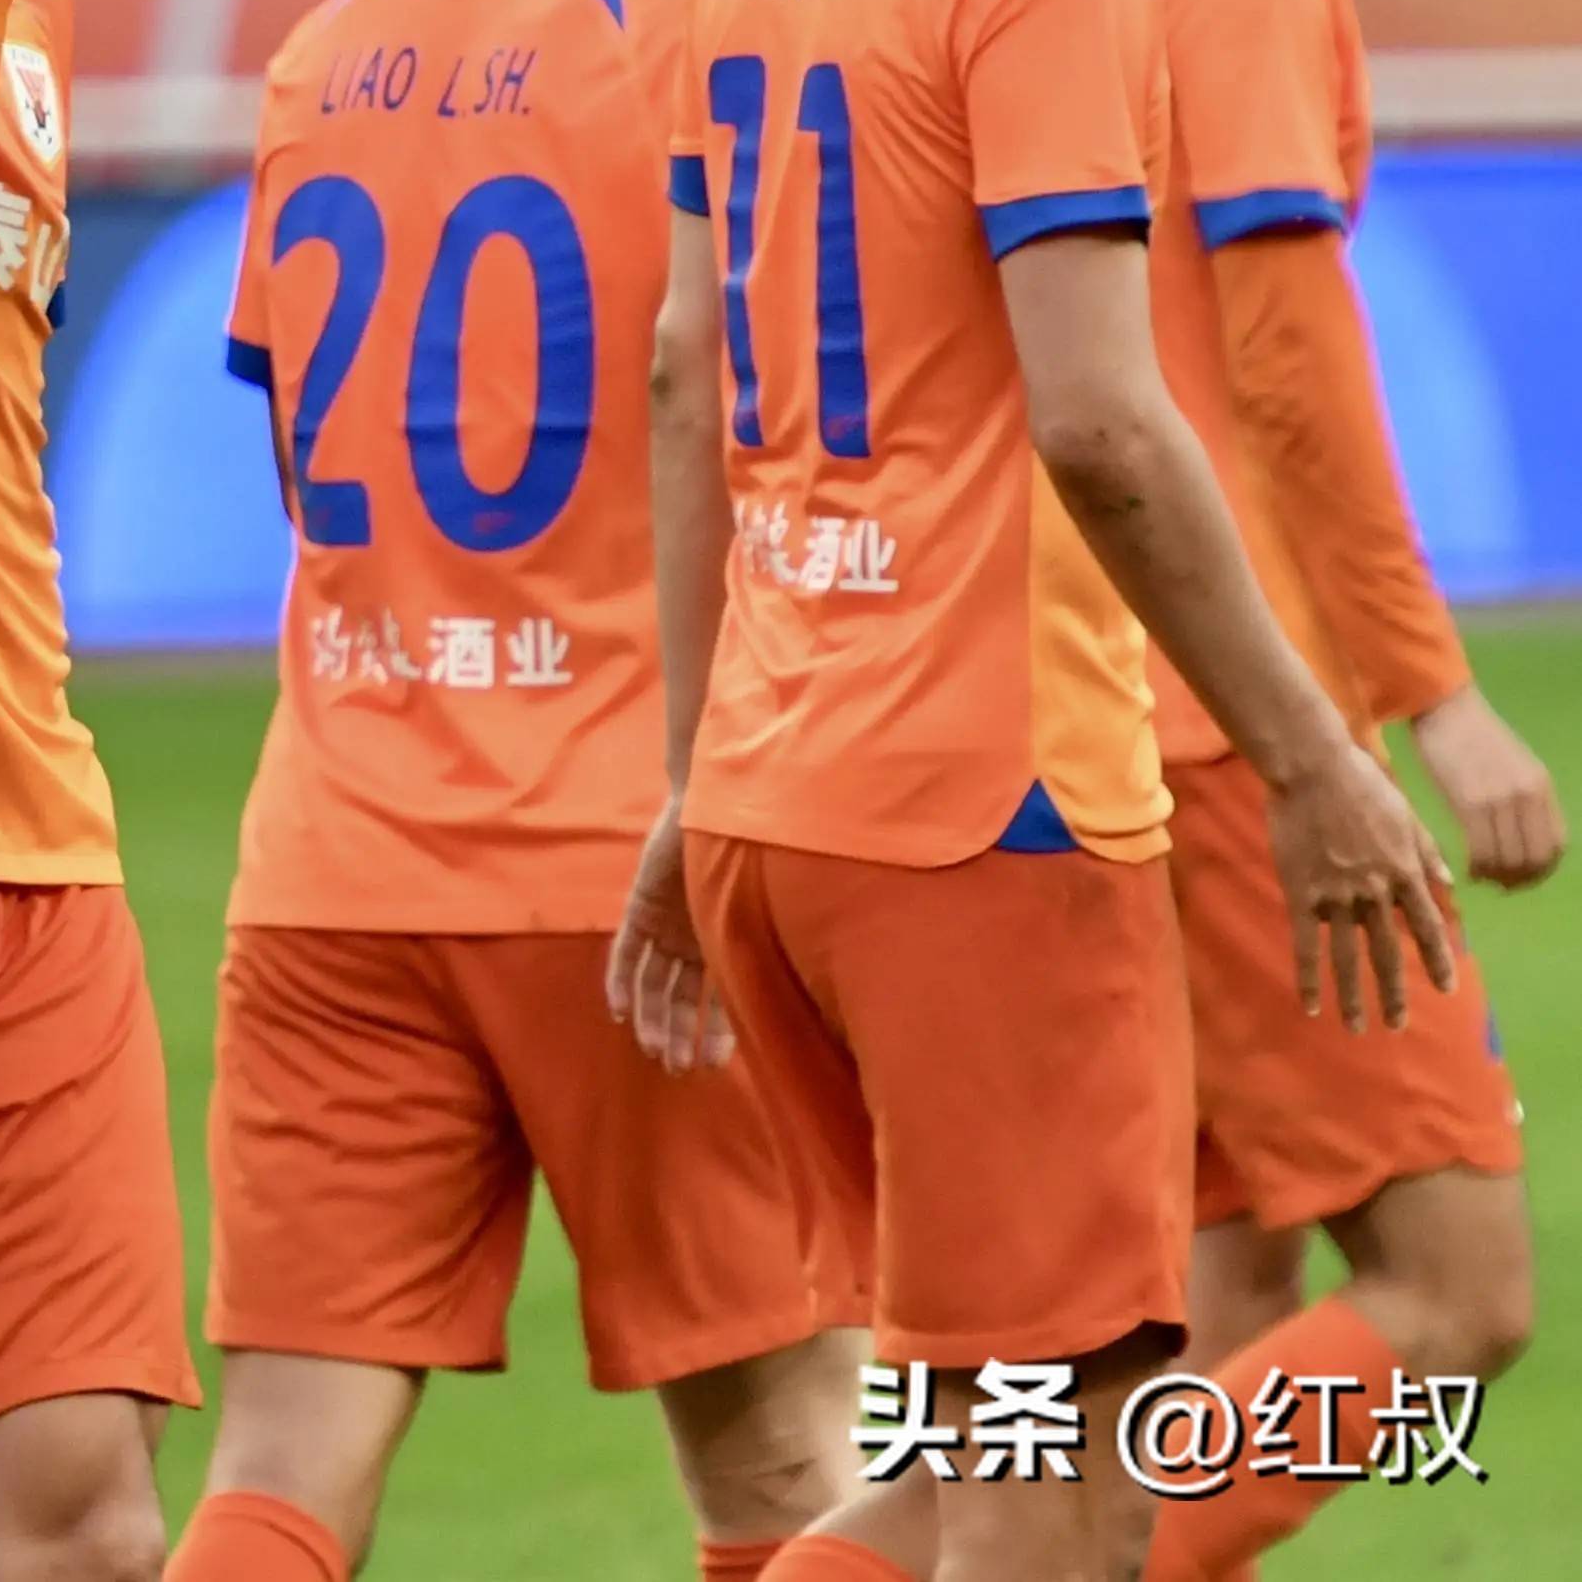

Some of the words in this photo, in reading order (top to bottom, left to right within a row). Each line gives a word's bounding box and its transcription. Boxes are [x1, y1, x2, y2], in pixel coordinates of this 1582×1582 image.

[321, 47, 416, 115] LIAO
[708, 54, 871, 457] 11
[272, 174, 594, 552] 20
